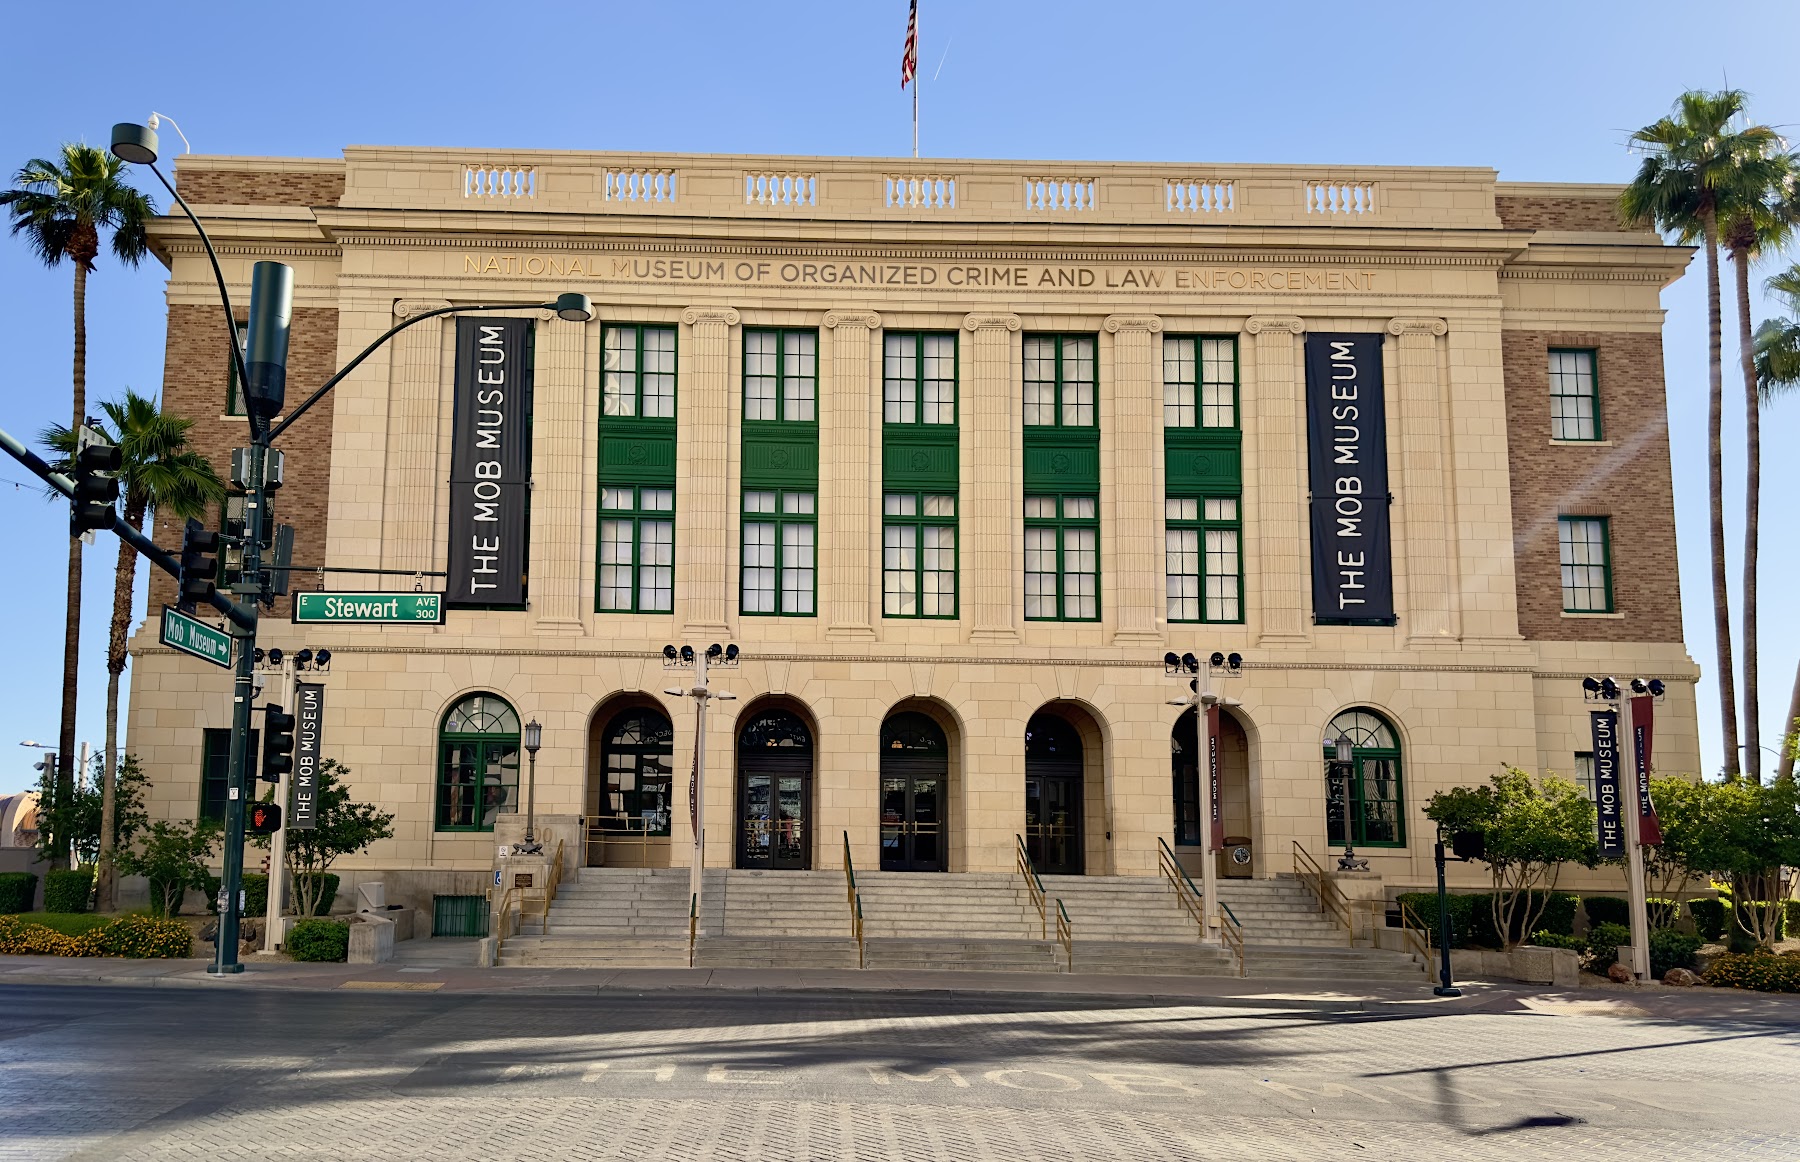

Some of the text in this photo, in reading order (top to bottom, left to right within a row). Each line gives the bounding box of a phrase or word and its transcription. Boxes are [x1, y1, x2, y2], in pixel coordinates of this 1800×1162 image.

[464, 254, 1377, 291] NATIONAL MUSEUM OF ORGANIZED CRIME AND LAW ENFORCEMENT
[471, 325, 505, 595] THE MOB MUSEUM
[1330, 341, 1366, 611] THE MOB MUSEUM
[168, 615, 217, 656] Mob Museum
[301, 596, 437, 618] E Stewart AVE
[415, 609, 435, 619] 300
[296, 689, 317, 822] THE MOB MUSEUM
[1597, 718, 1617, 850] THE MOB MUSEUM
